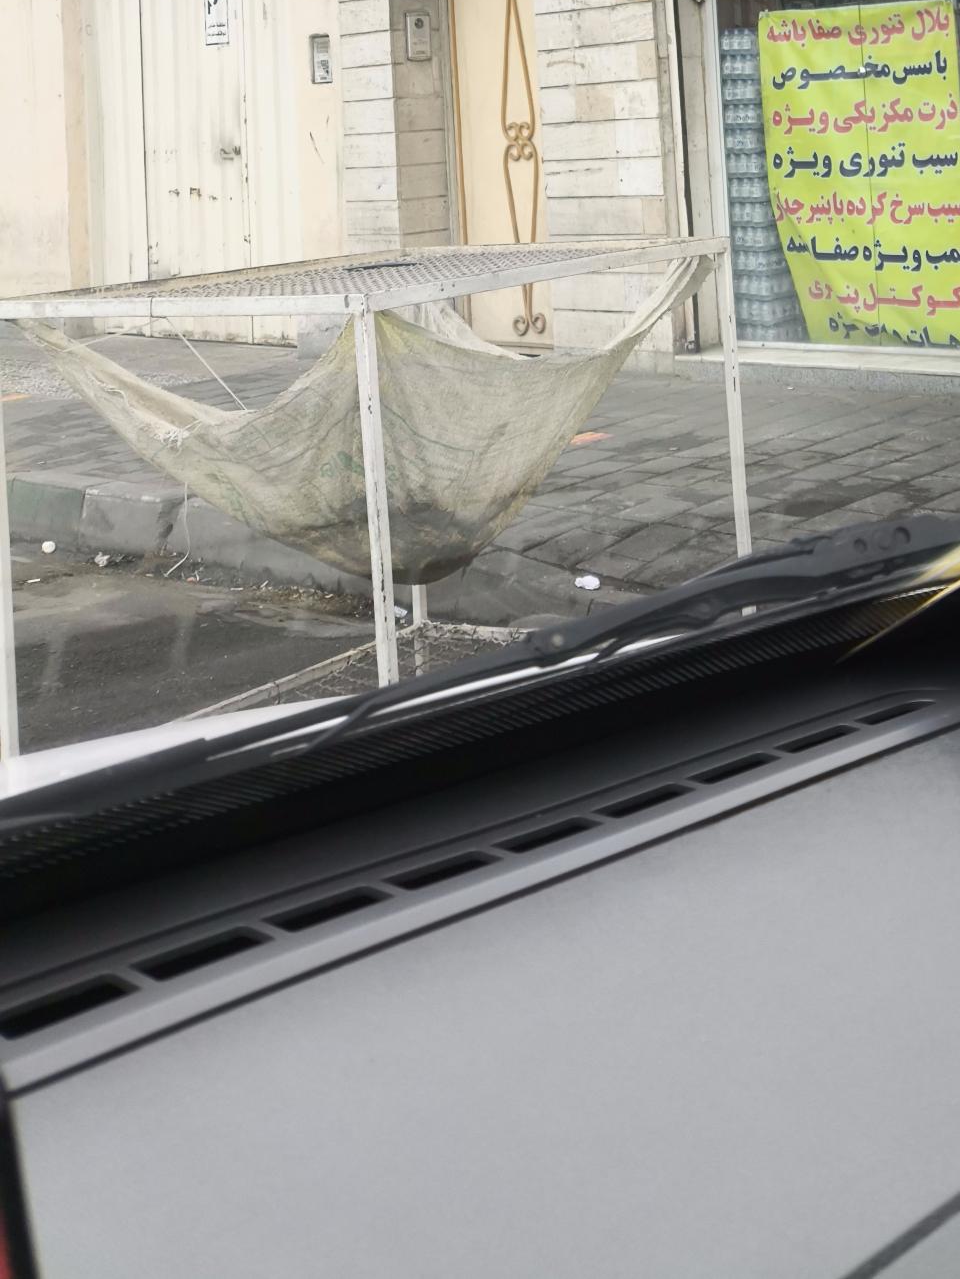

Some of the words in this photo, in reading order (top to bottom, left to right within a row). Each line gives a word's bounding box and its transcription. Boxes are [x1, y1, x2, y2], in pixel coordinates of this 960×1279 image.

[767, 19, 807, 48] باشه
[808, 18, 842, 41] صفا
[848, 13, 905, 46] تنوری
[911, 6, 951, 41] بلال
[772, 54, 891, 90] مخصوص
[892, 59, 933, 85] سس
[935, 50, 947, 81] با
[772, 103, 830, 135] ویژه
[833, 98, 914, 134] مکزیکی
[918, 93, 958, 130] ذرت
[772, 146, 833, 179] ویژه
[839, 142, 905, 179] تنوری
[912, 151, 959, 175] سیب
[806, 195, 832, 225] پنیر
[832, 191, 845, 222] با
[846, 191, 887, 225] کرده
[889, 193, 924, 225] سرخ
[862, 239, 922, 272] ویژه
